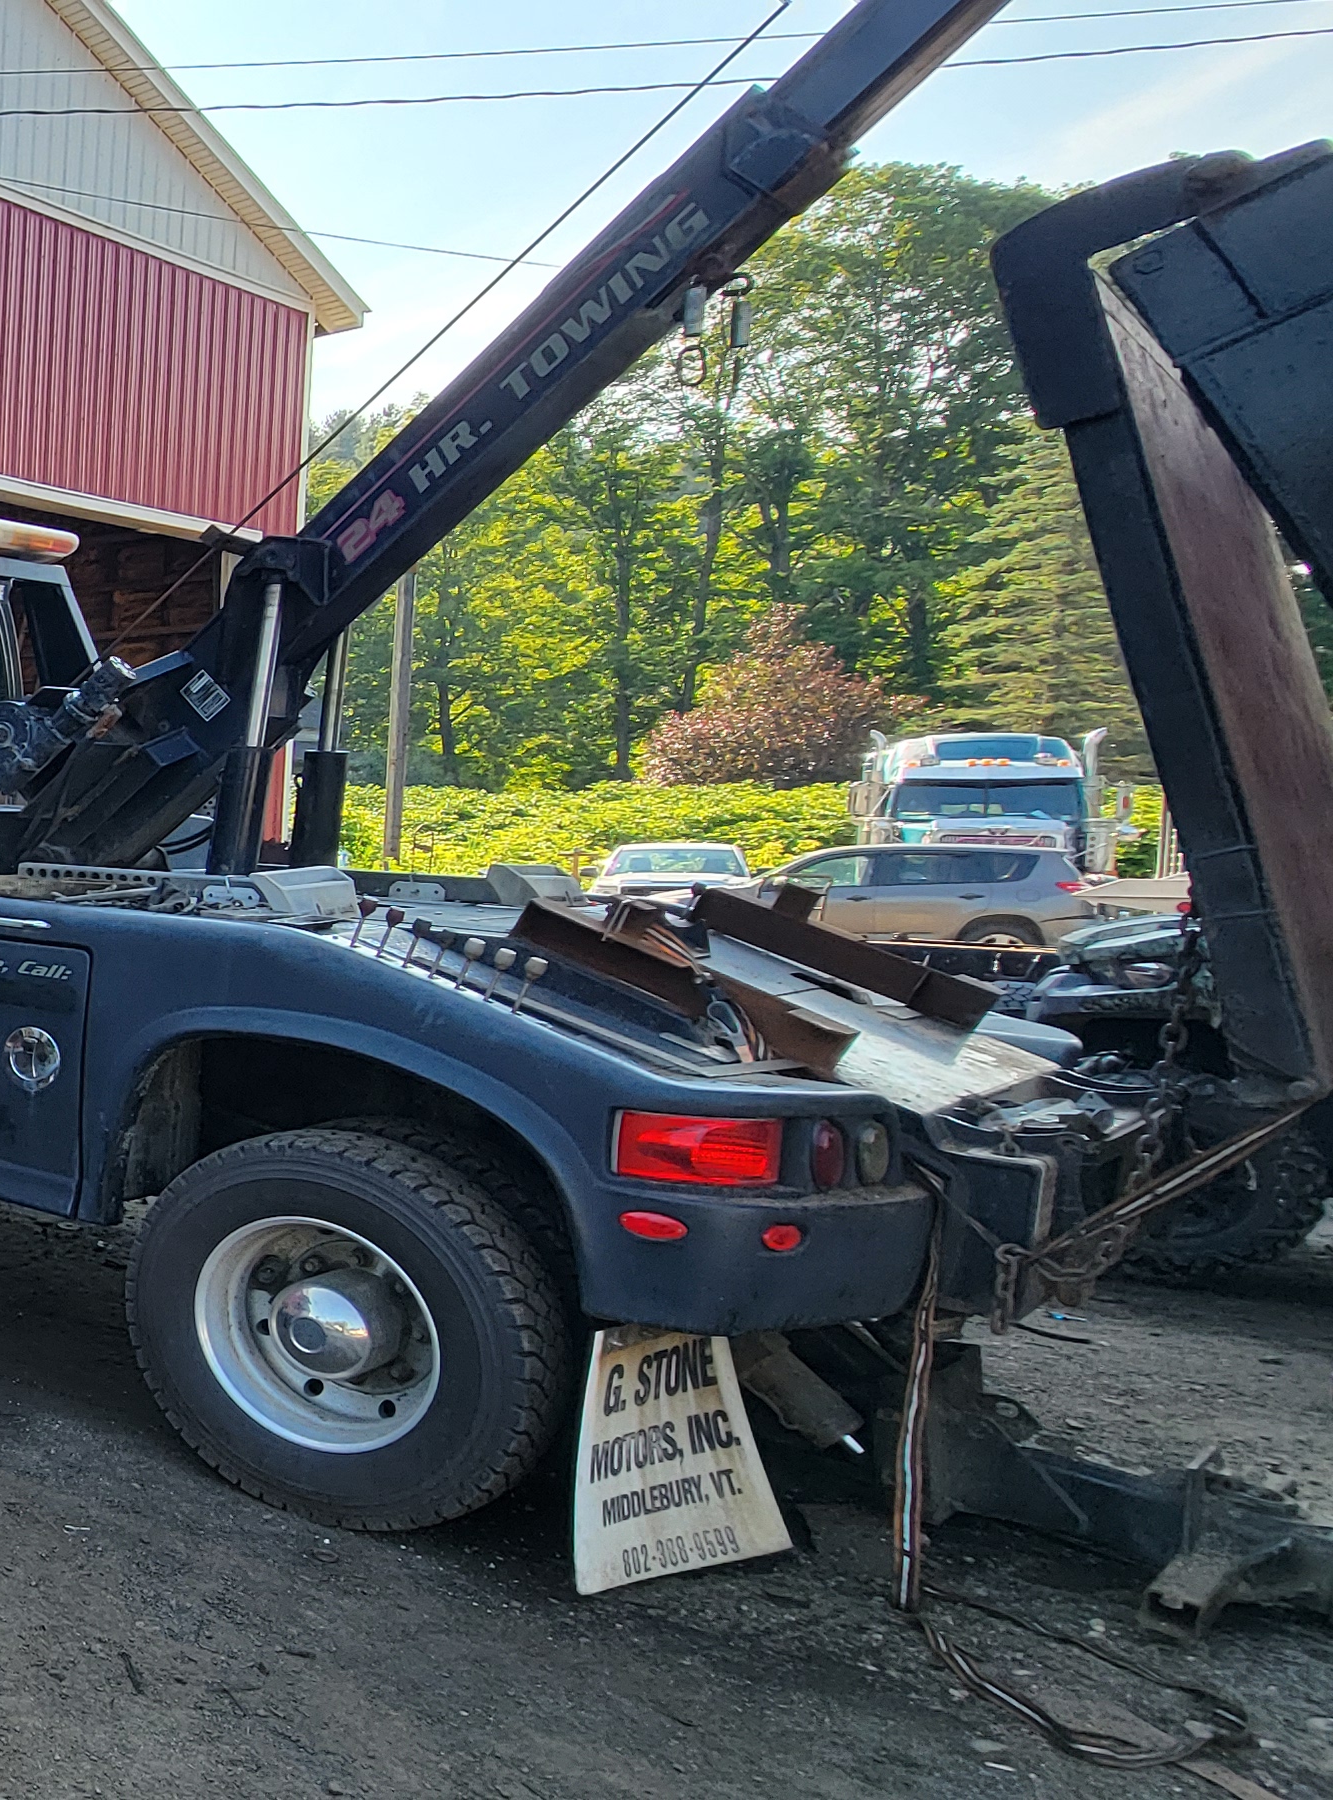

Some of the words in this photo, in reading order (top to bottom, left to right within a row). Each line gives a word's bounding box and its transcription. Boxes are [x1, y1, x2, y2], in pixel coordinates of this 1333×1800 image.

[338, 488, 408, 564] 24
[408, 418, 494, 494] HR.
[499, 202, 711, 400] TOWING
[17, 960, 73, 981] Call:
[603, 1363, 627, 1417] G.
[634, 1337, 718, 1406] STONE
[590, 1421, 683, 1484] MOTORS,
[686, 1408, 742, 1456] INC.
[601, 1475, 710, 1528] MIDDLEBURY,
[709, 1468, 744, 1500] VT.
